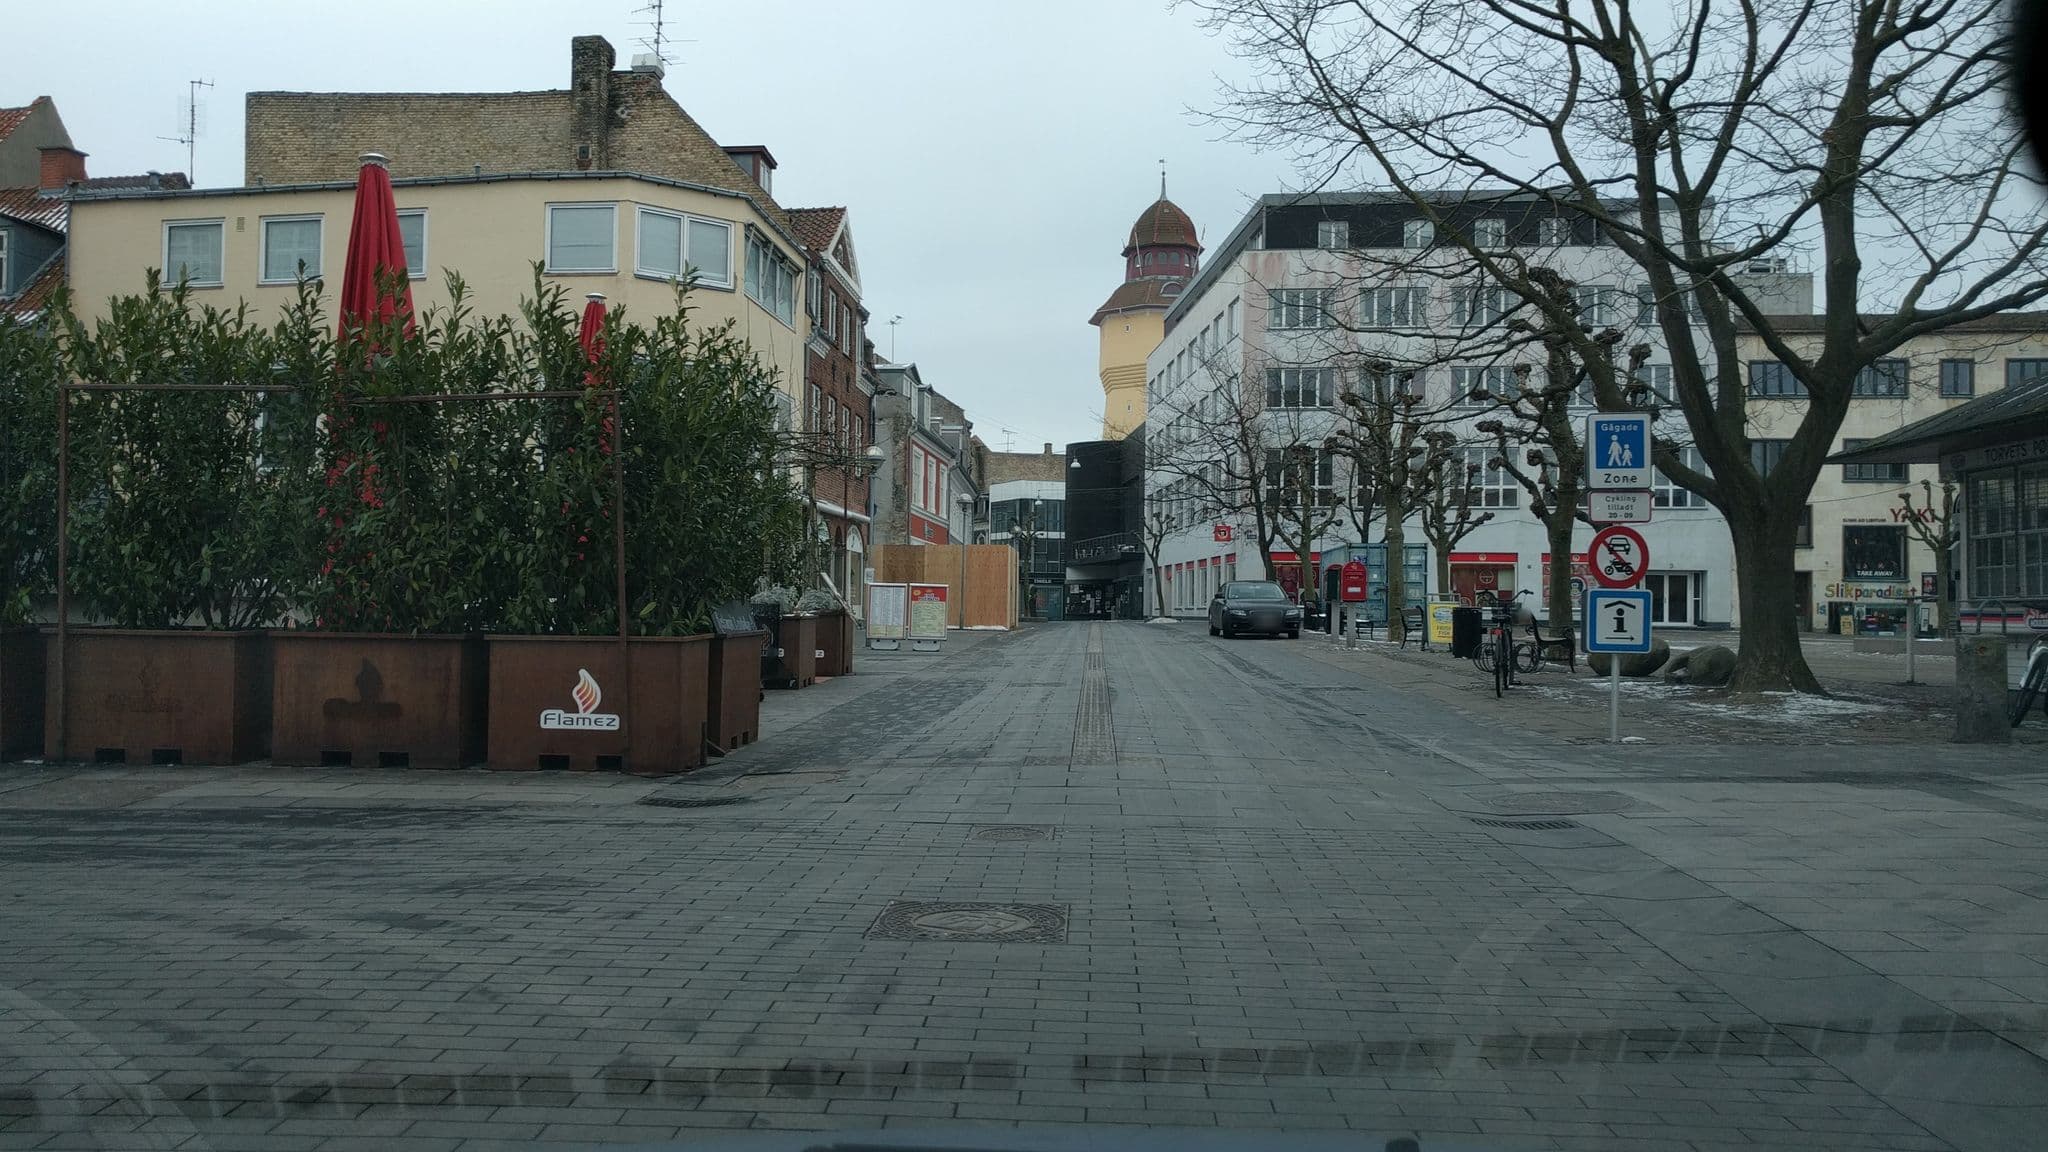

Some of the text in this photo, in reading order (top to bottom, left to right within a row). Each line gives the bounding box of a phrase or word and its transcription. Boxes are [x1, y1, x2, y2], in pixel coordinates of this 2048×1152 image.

[1600, 423, 1638, 432] Gågade
[1603, 473, 1638, 483] Zone
[1605, 495, 1637, 503] Cykling
[1824, 583, 1917, 601] Slikparadiset
[543, 712, 617, 727] Flamez
